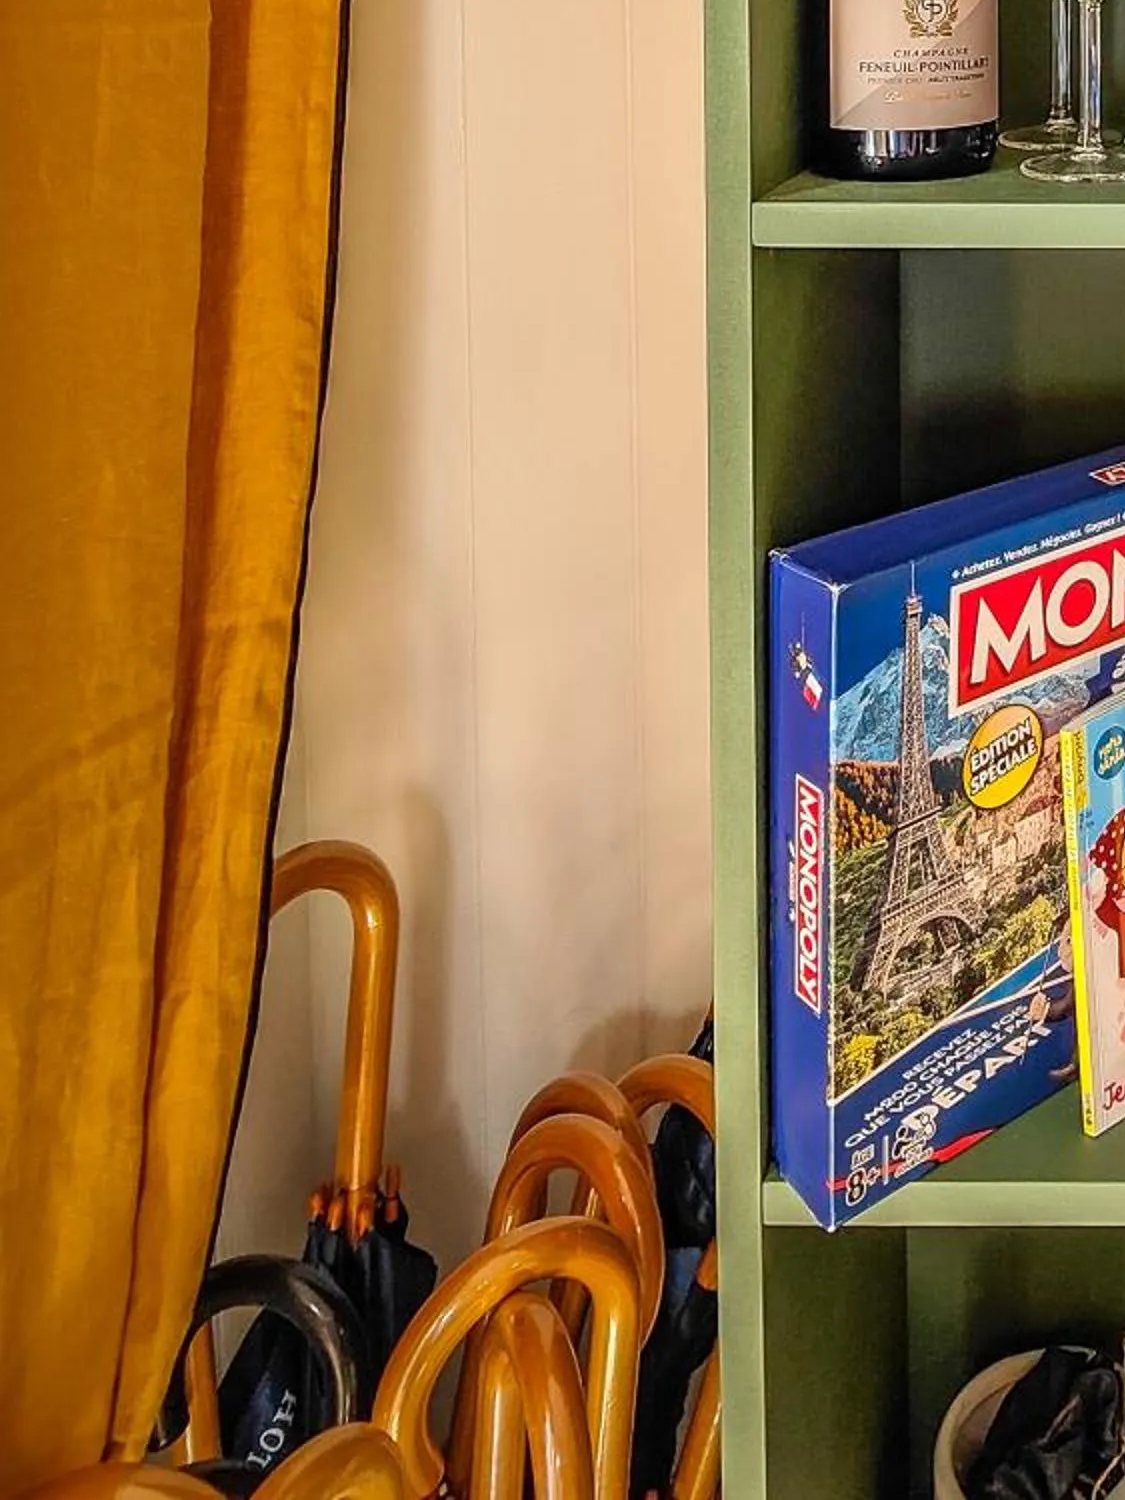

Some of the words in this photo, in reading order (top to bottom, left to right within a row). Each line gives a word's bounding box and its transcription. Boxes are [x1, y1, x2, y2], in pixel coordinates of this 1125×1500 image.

[893, 47, 969, 59] CHAMPAGNE
[799, 787, 818, 1006] MONOPOLY
[845, 1114, 890, 1148] QUE
[889, 1077, 944, 1113] VOUS
[944, 1032, 1006, 1077] PASSEZ
[1004, 1012, 1032, 1034] PA
[902, 1028, 976, 1080] RECEVEZ
[920, 1029, 993, 1082] CHAQUE
[992, 1005, 1028, 1030] FOIS
